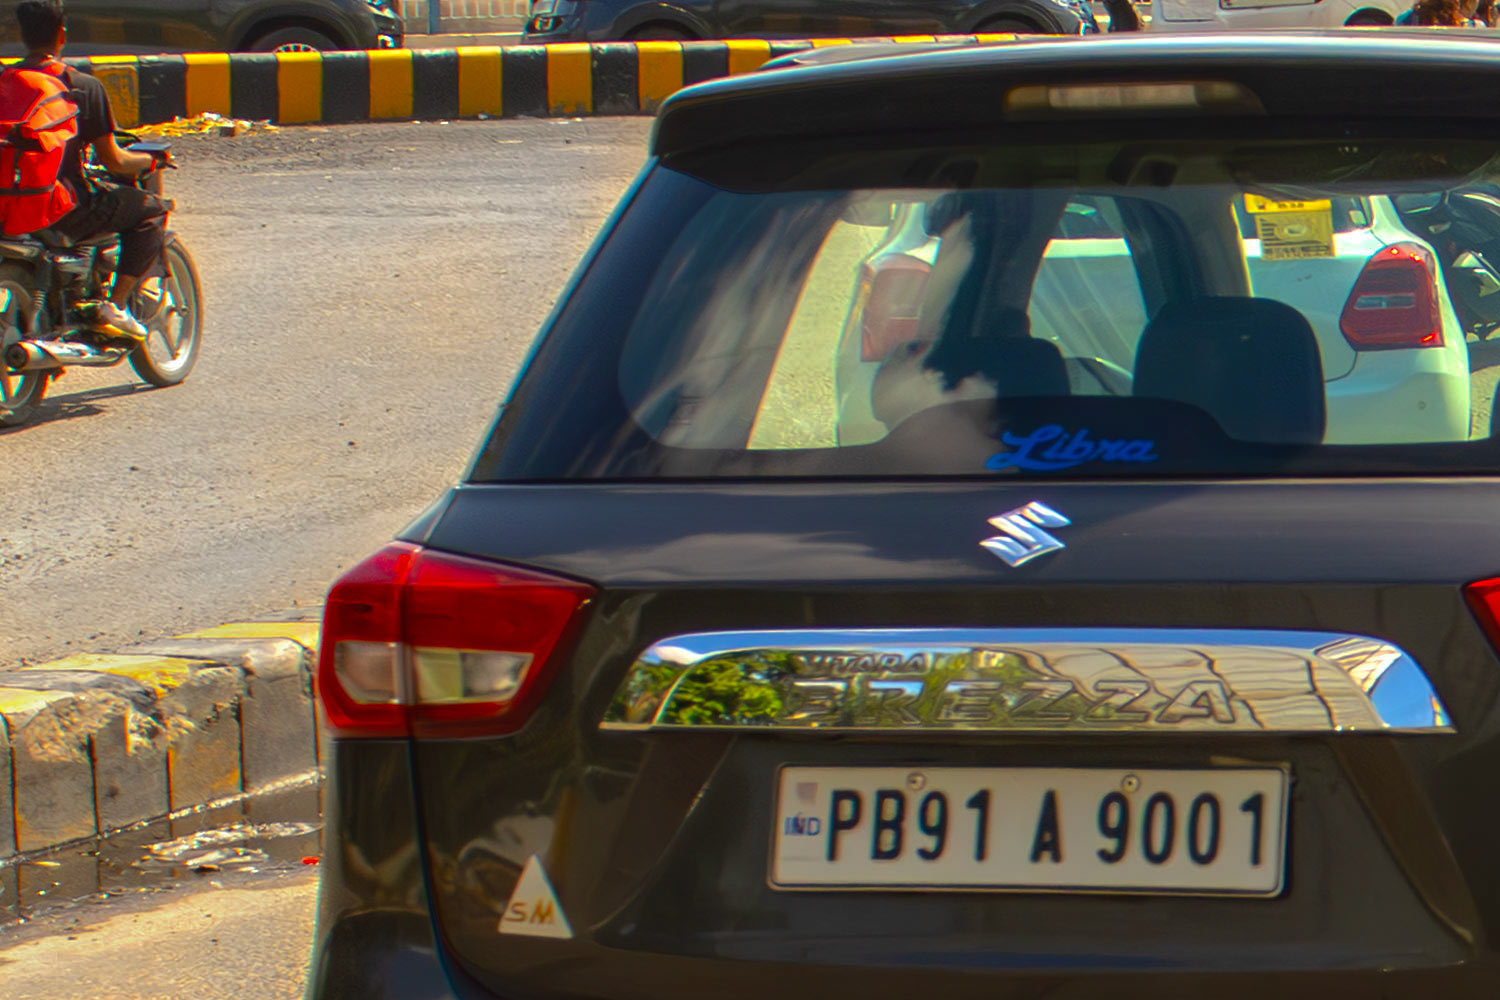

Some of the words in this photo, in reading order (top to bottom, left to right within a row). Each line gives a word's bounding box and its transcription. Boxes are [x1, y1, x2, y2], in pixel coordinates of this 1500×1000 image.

[985, 424, 1160, 471] Libra
[799, 652, 934, 675] VITARA
[786, 678, 1236, 724] BREZZA
[784, 816, 820, 836] IND
[827, 788, 993, 863] PB91
[1029, 789, 1063, 863] A
[1096, 792, 1266, 867] 9001
